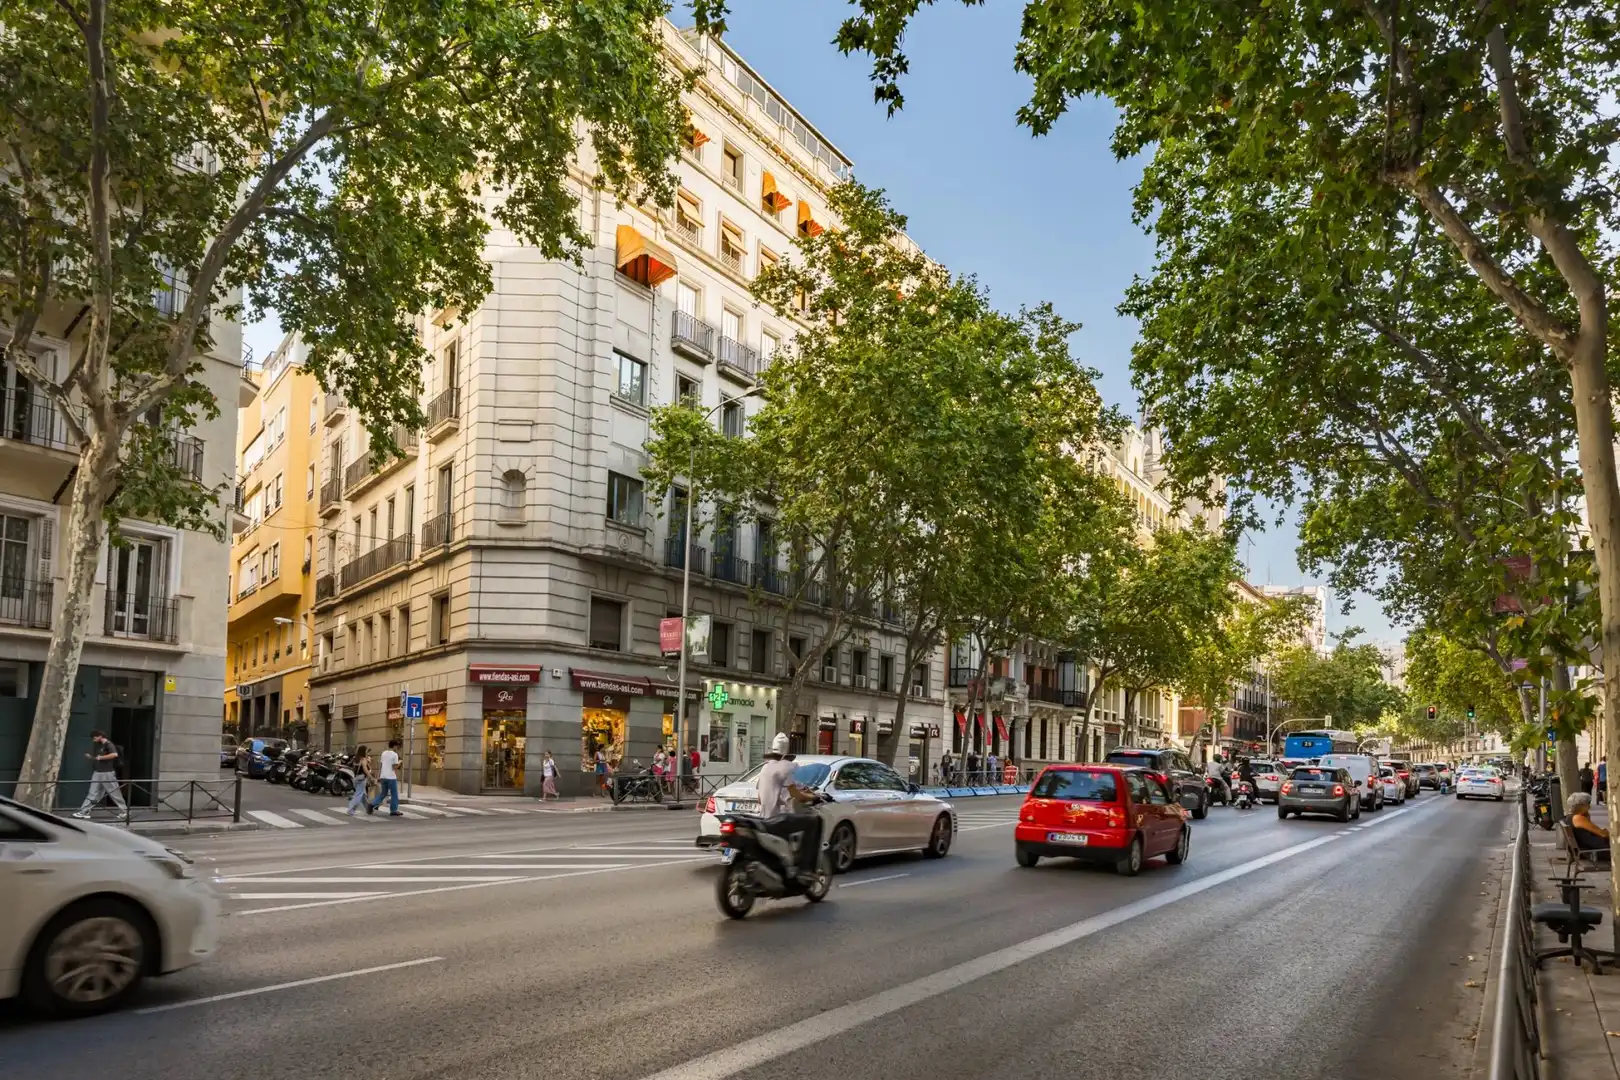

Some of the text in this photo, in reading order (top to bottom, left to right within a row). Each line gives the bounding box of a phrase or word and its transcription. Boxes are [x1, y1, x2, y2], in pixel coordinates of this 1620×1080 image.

[479, 672, 530, 681] www.tiendas-asi.com
[580, 680, 643, 694] www.tiendas-asi.com
[724, 697, 755, 707] armacia
